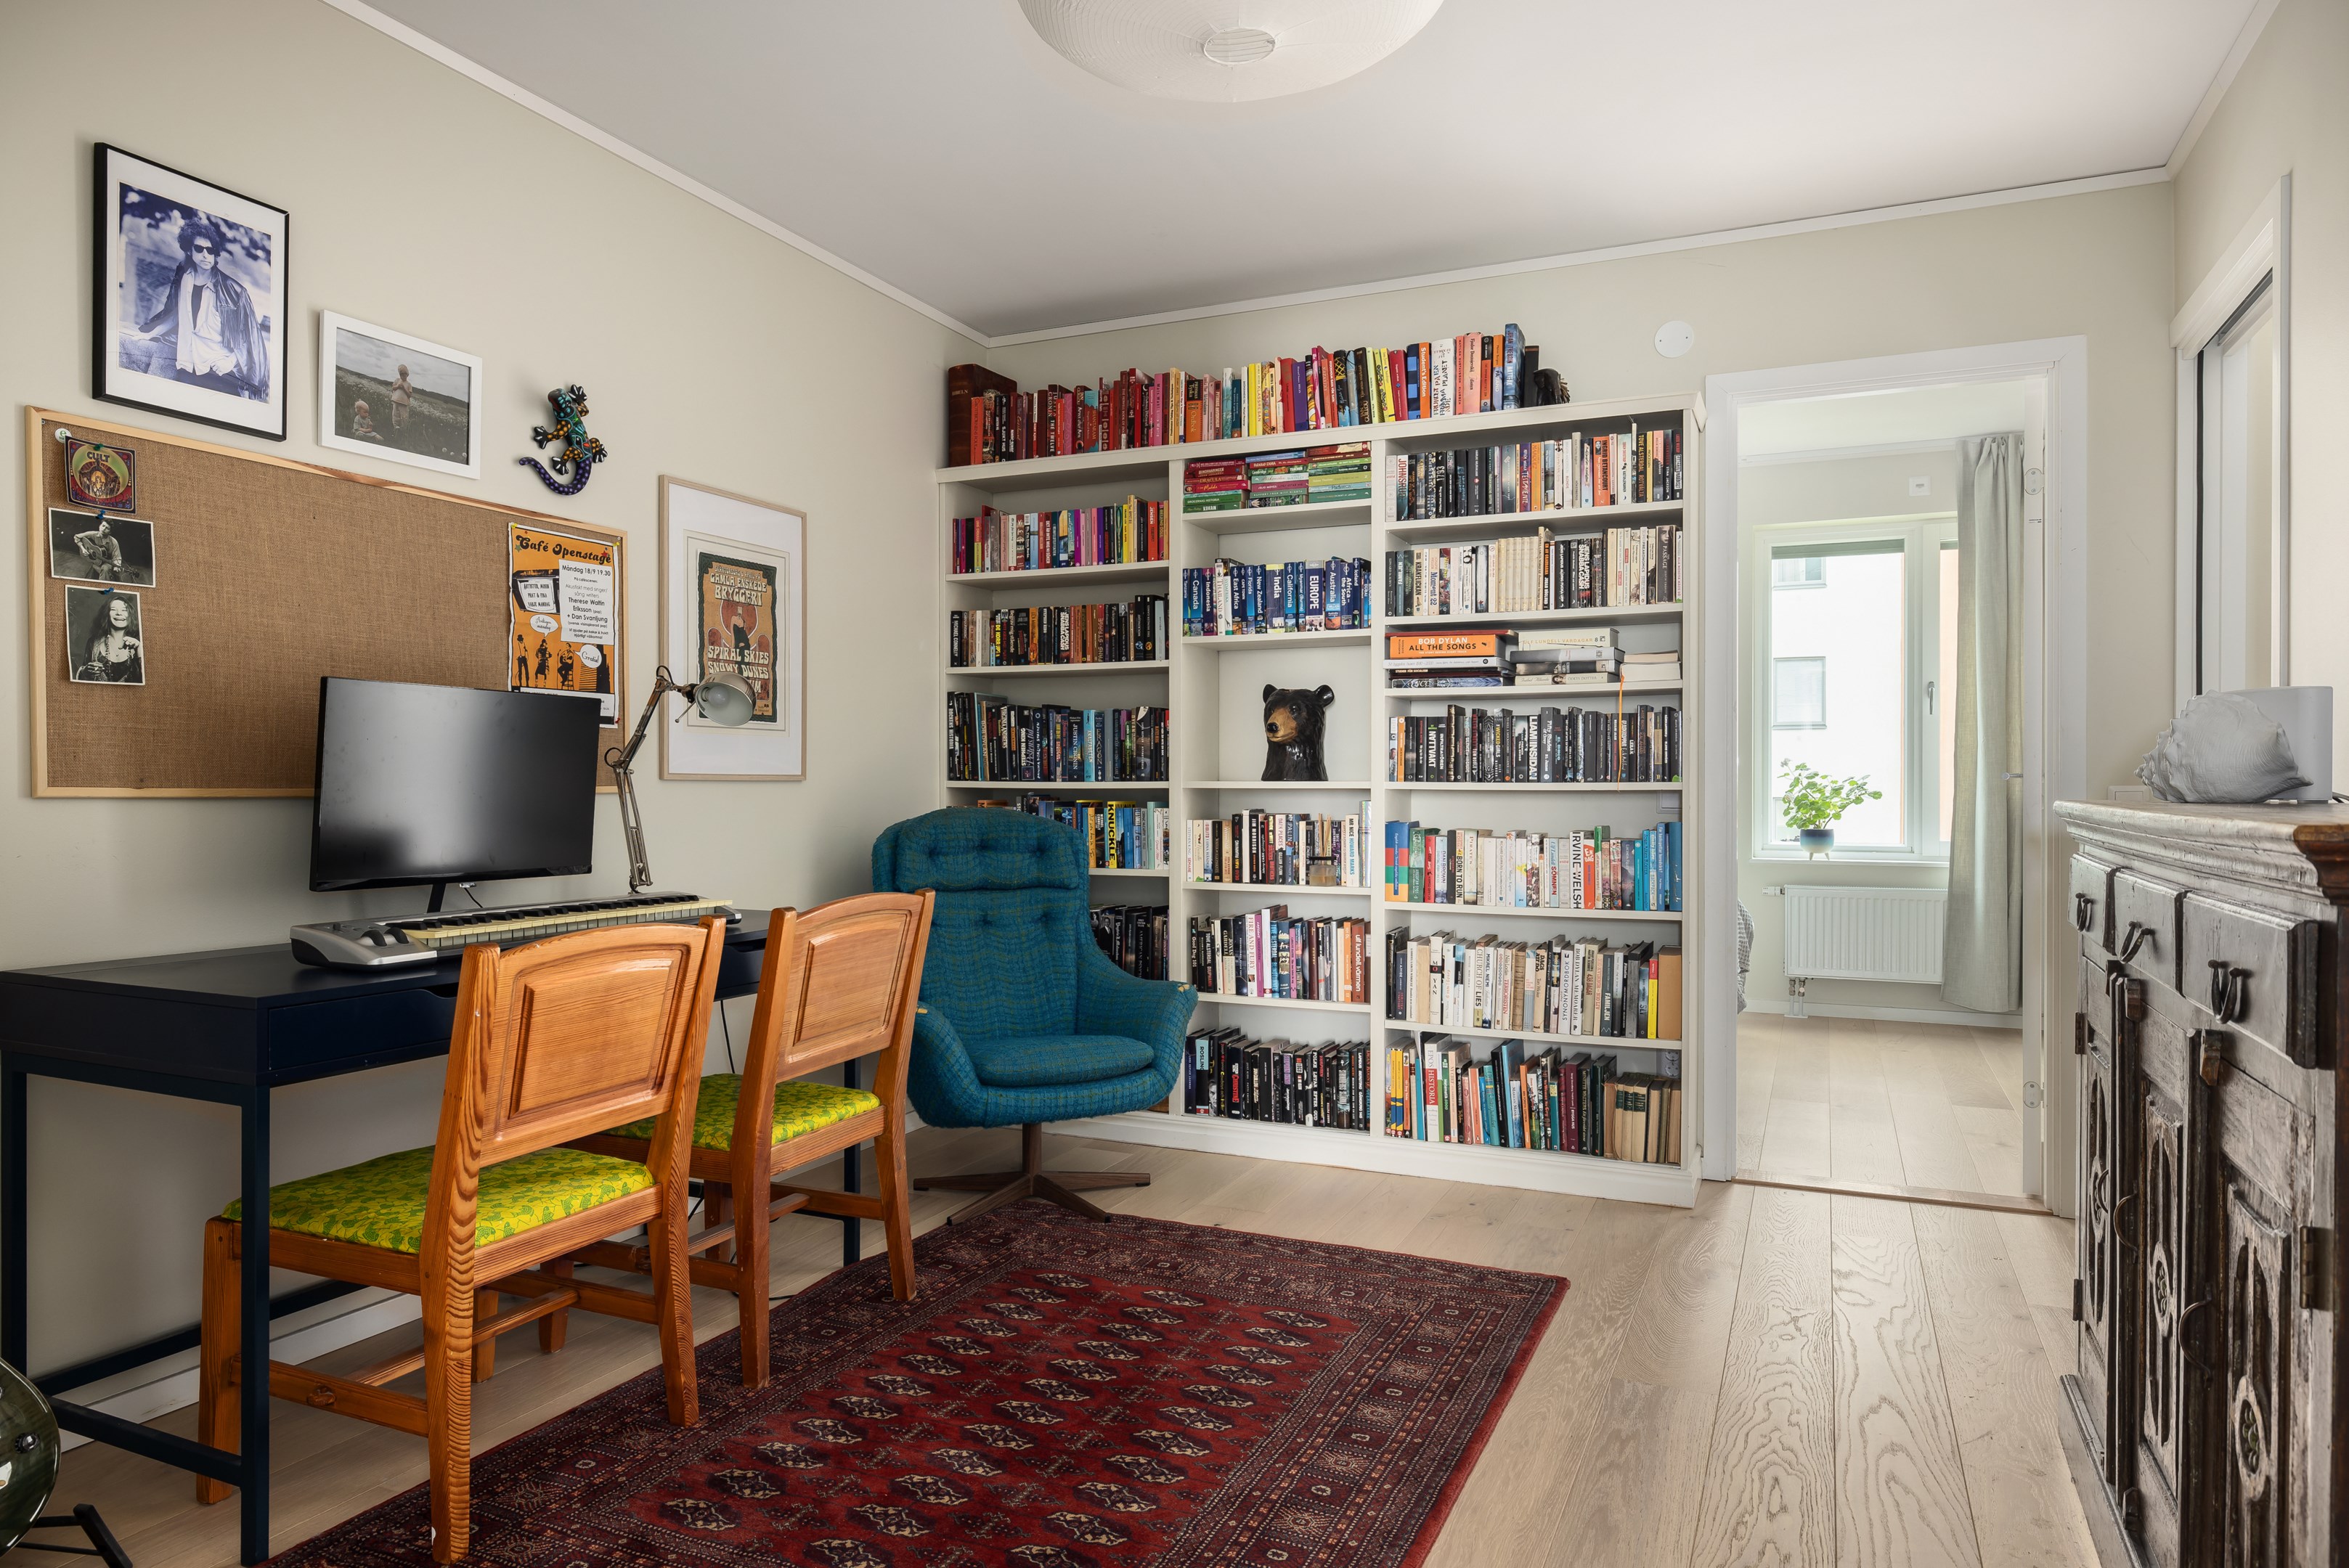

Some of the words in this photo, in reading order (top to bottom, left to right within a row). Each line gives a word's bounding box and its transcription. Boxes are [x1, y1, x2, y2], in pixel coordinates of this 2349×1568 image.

[87, 451, 110, 463] CULT
[1399, 458, 1407, 498] JOHNSRUD
[516, 535, 549, 552] Café
[552, 543, 611, 565] Openstage
[562, 565, 583, 574] Måndag
[711, 573, 735, 586] GAMLA
[737, 578, 768, 592] ENSKEDE
[1309, 575, 1319, 609] EUROPE
[715, 585, 763, 606] BRYGGERI
[583, 615, 608, 623] Svanljung
[708, 645, 741, 662] SPIRAL
[744, 650, 769, 665] SKIES
[742, 666, 769, 679] DUNES
[1572, 832, 1581, 868] IRVINE
[1572, 871, 1581, 908] WELSH
[1476, 980, 1483, 990] OF
